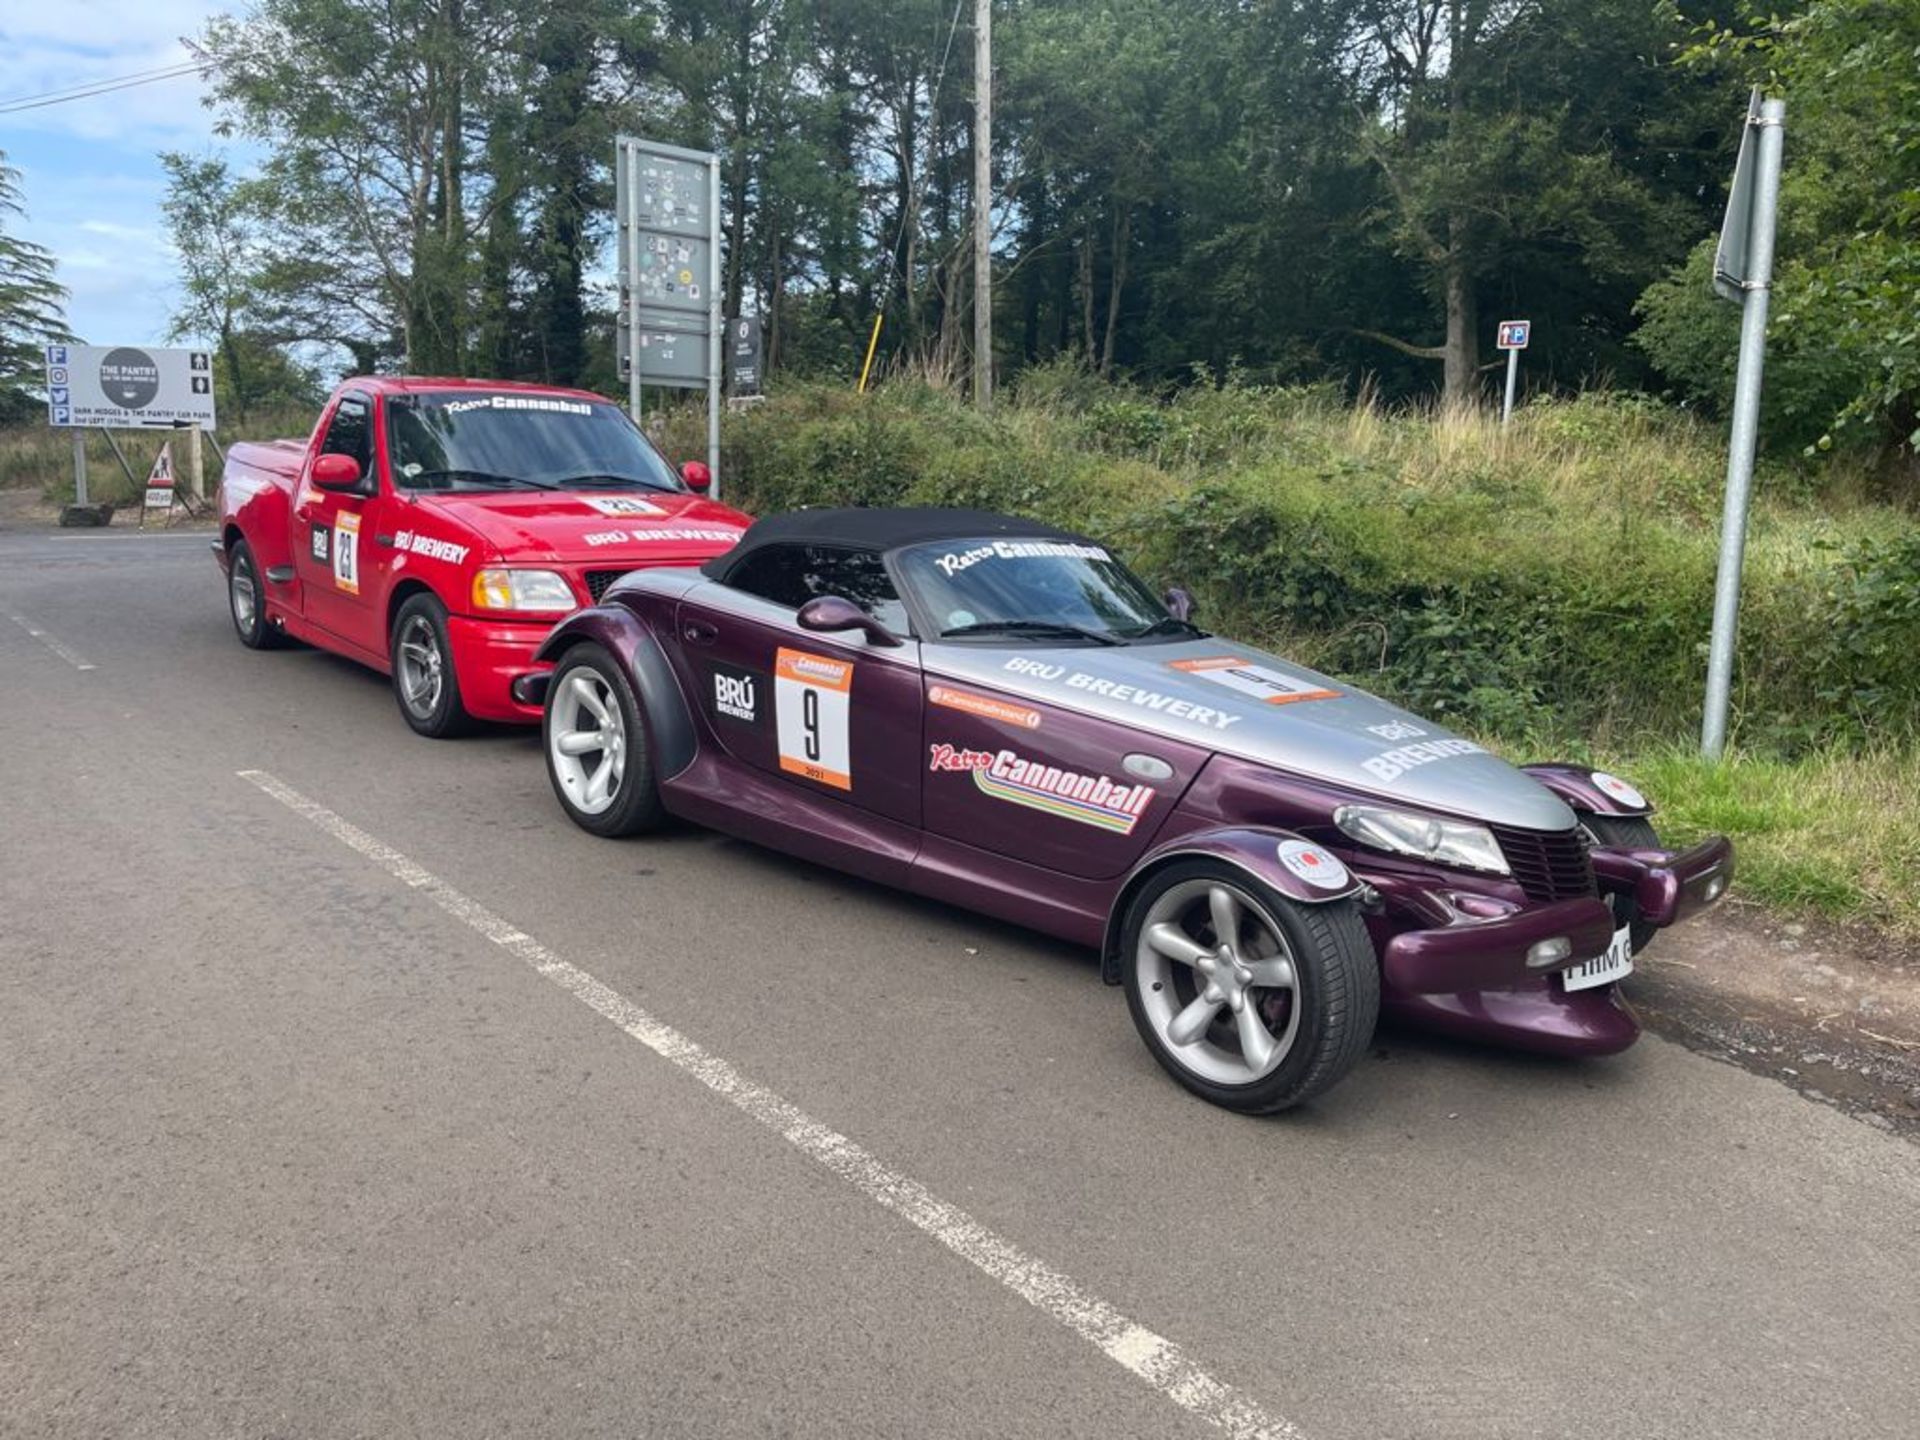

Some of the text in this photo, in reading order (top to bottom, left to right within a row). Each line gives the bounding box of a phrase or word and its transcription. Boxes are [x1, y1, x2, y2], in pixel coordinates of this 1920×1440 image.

[102, 365, 157, 377] THE PANTRY
[147, 410, 175, 419] PANTRY
[443, 396, 592, 416] Retro Cannonball
[410, 534, 470, 565] BREWERY
[631, 529, 742, 543] BREWERY
[339, 532, 352, 580] 23
[934, 541, 1113, 577] Retro Cannonball
[714, 672, 755, 711] BRÚ
[1065, 673, 1242, 730] BREWERY
[716, 700, 756, 722] BREWERY
[803, 688, 820, 762] 9
[805, 766, 825, 780] 2021
[930, 744, 1155, 817] Retro Cannonball
